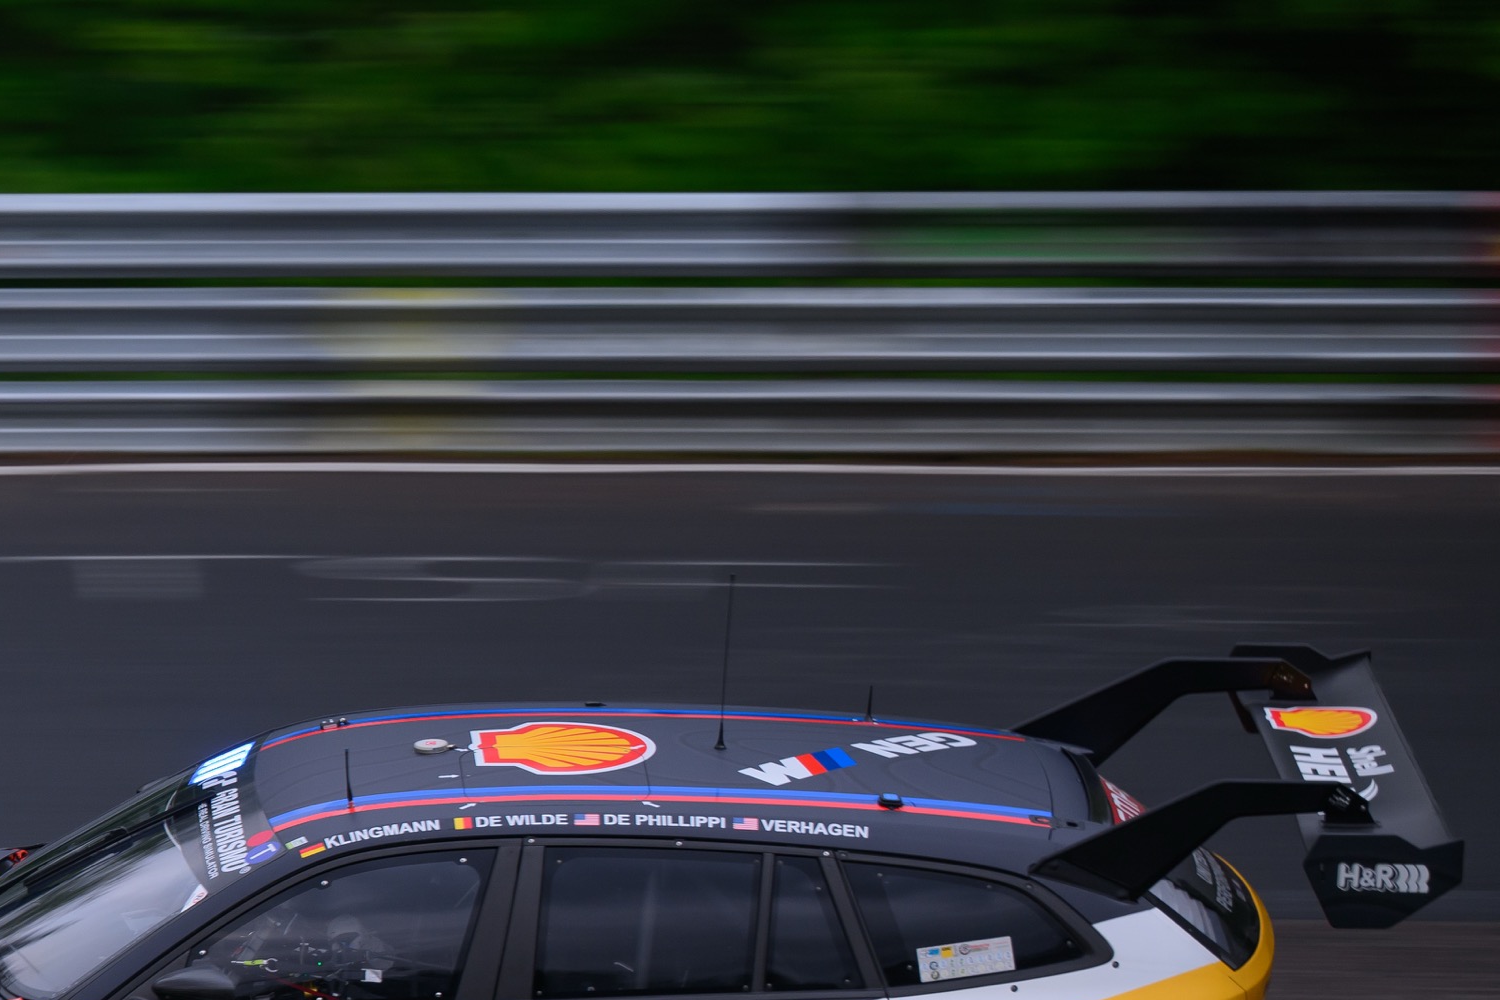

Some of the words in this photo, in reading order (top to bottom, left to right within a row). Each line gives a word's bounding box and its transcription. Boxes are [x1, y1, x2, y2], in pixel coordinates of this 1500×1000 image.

[851, 732, 977, 758] GEN
[1346, 744, 1395, 777] Shell
[211, 787, 240, 820] GRAN
[323, 819, 440, 850] KLINGMANN
[475, 816, 503, 828] DE
[507, 814, 568, 826] WILDE
[603, 813, 631, 826] DE
[635, 814, 726, 829] PHILLIPPI
[761, 819, 869, 839] VERHAGEN
[203, 842, 220, 880] SIMULATOR
[249, 843, 277, 860] T
[1337, 862, 1398, 892] H&R
